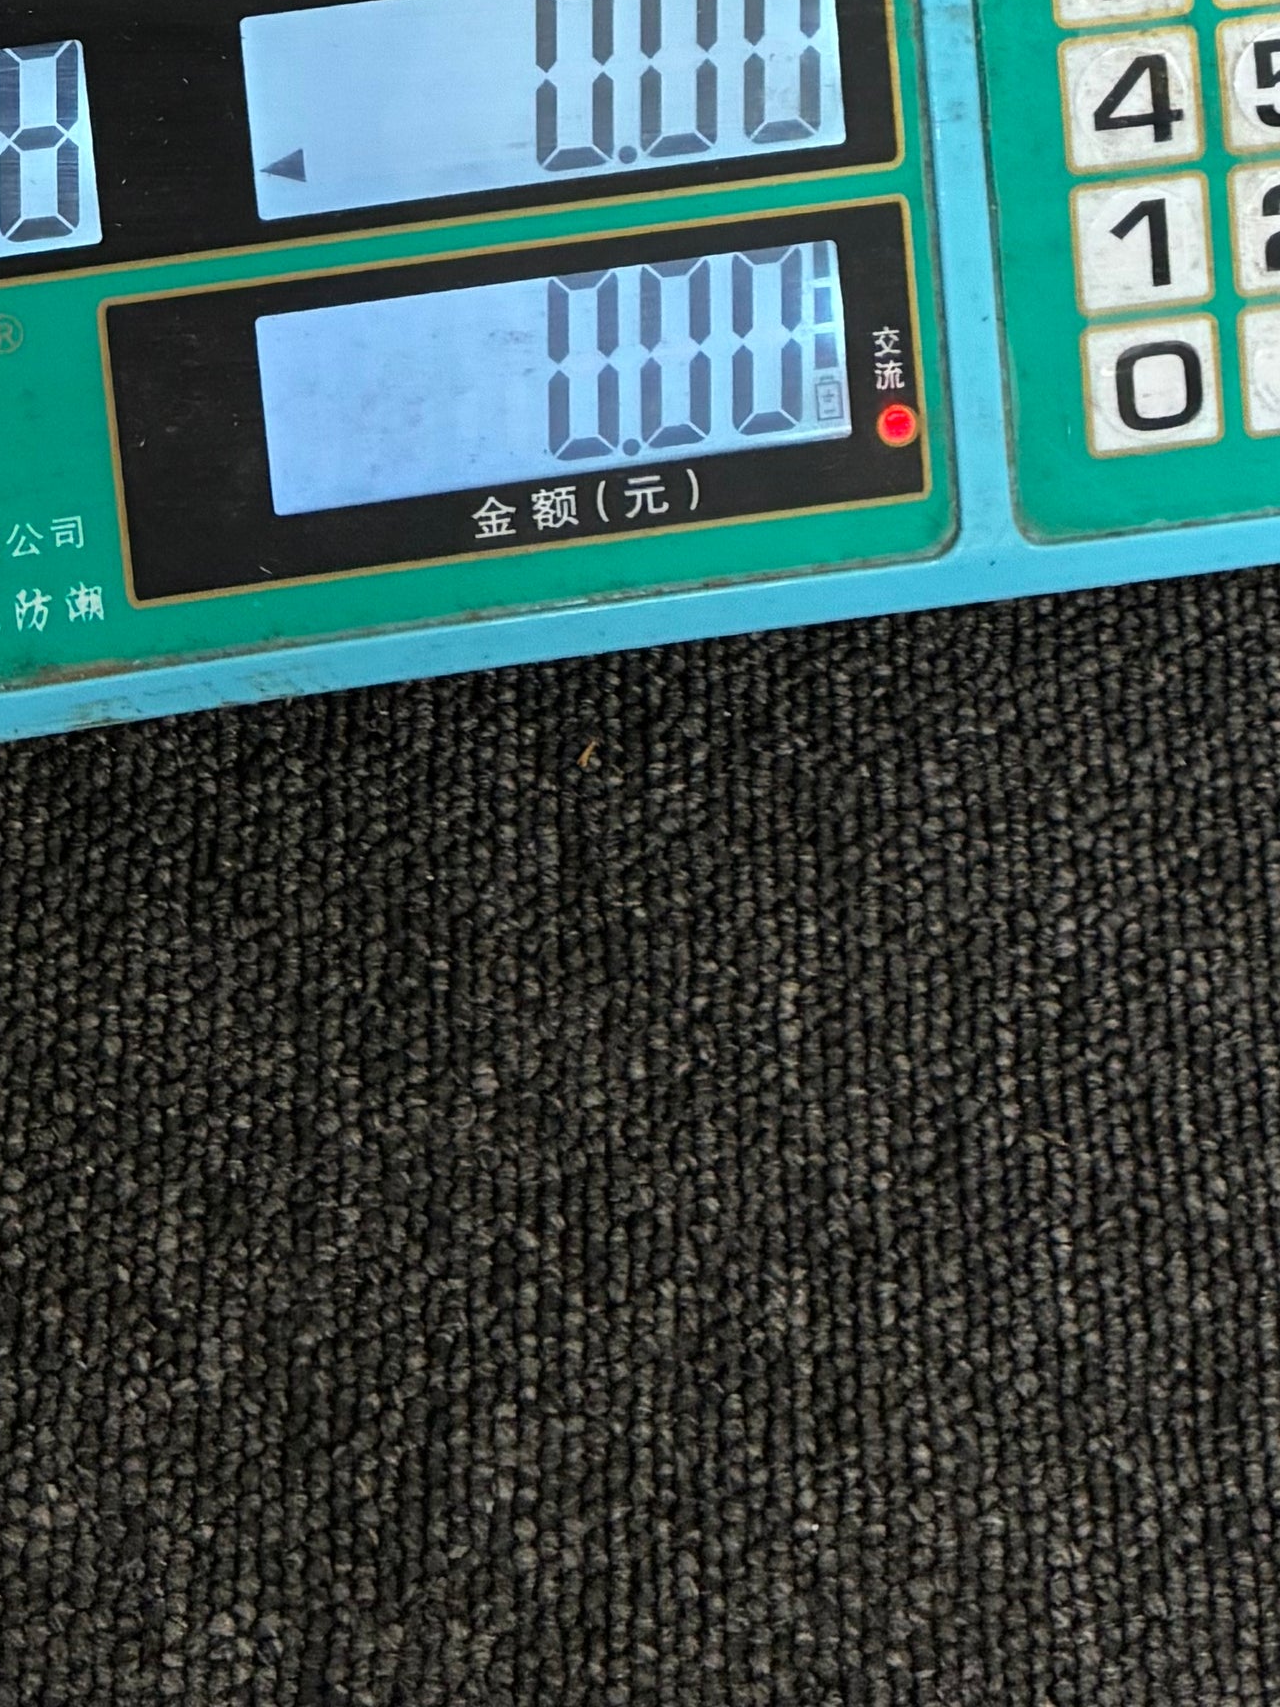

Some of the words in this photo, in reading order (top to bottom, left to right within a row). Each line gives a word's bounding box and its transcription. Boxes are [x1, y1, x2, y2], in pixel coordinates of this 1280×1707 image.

[1094, 54, 1184, 143] 4
[1109, 198, 1171, 287] 1
[546, 243, 803, 462] 0.00
[872, 325, 906, 391] 交流
[1115, 339, 1203, 432] 0
[471, 468, 702, 541] 金额(元)
